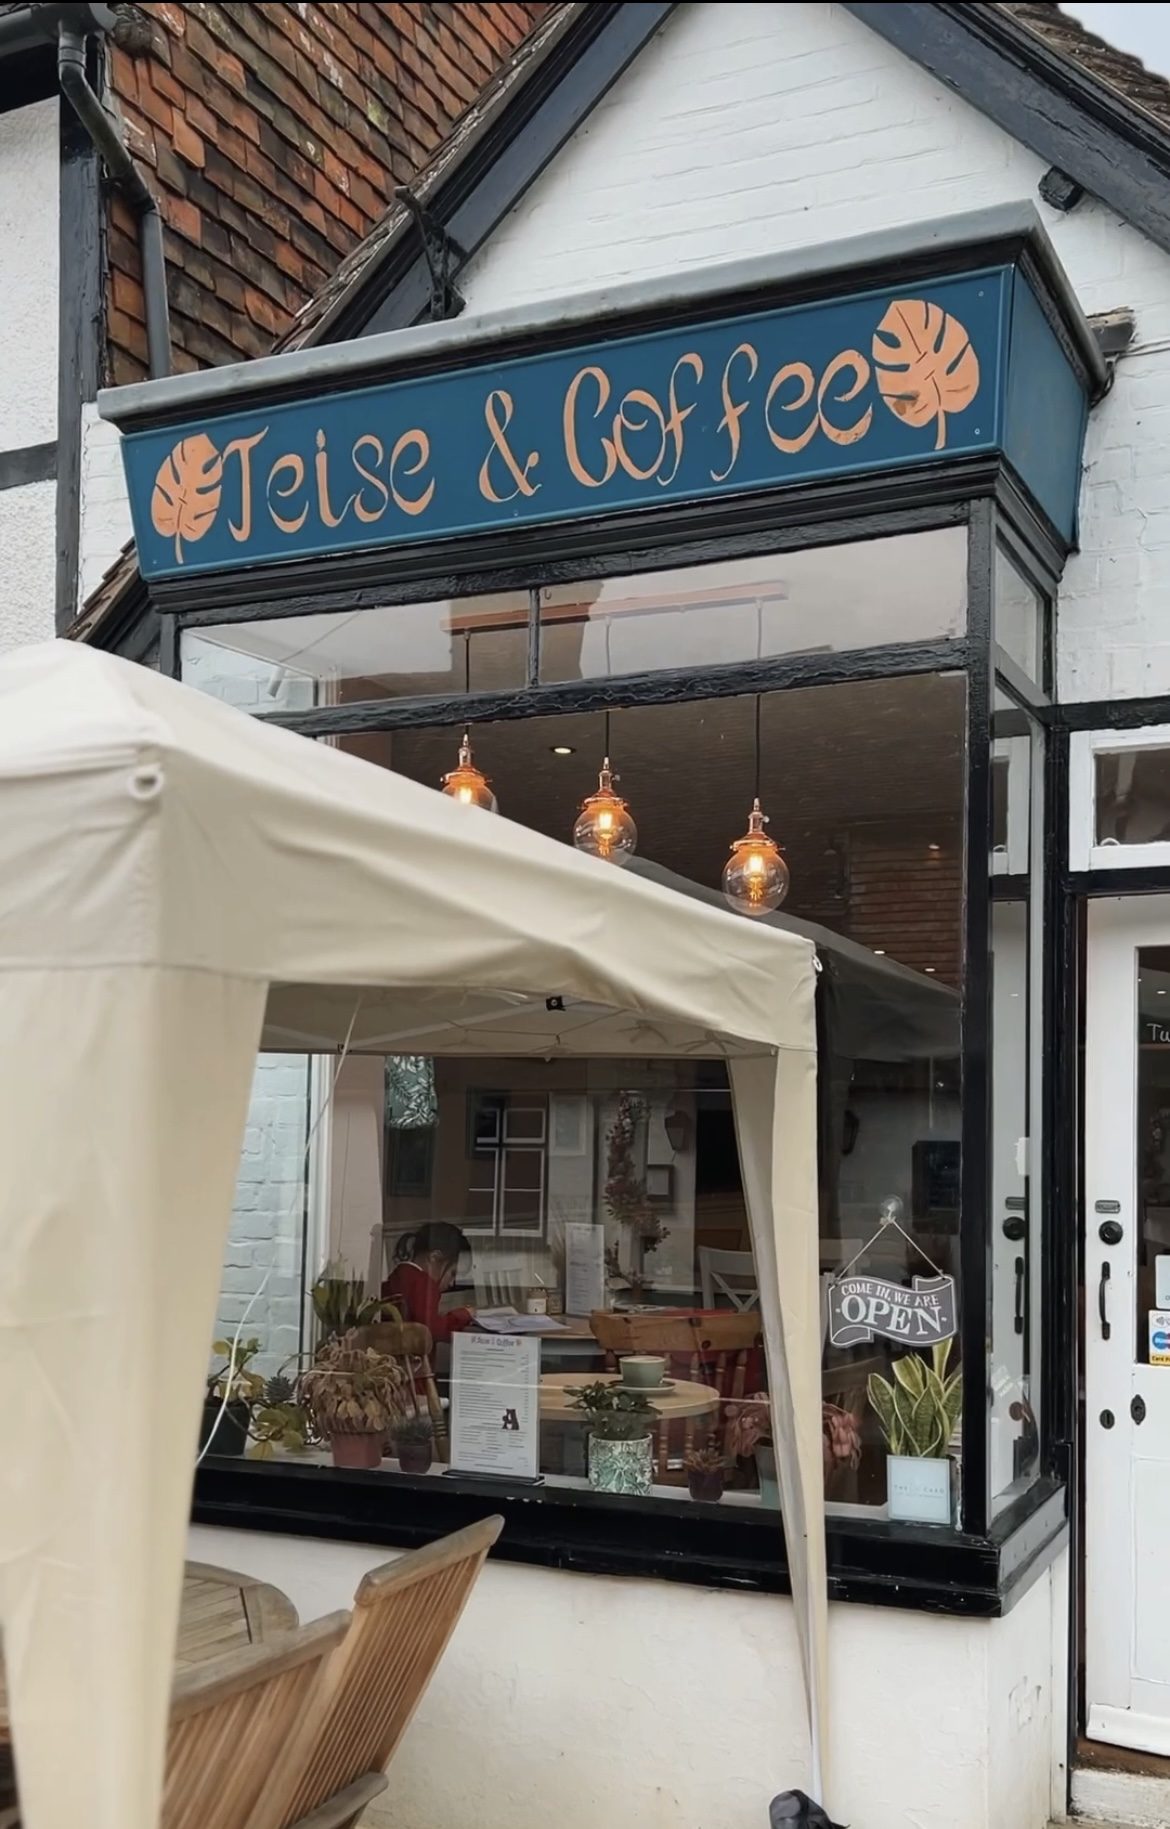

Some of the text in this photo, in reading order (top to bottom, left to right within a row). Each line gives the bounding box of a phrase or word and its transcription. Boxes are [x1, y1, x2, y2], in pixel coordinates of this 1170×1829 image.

[222, 343, 874, 543] Teise & Coffee
[841, 1282, 873, 1296] COME
[894, 1291, 911, 1306] WE
[914, 1294, 940, 1307] ARE
[841, 1294, 942, 1335] OPEN
